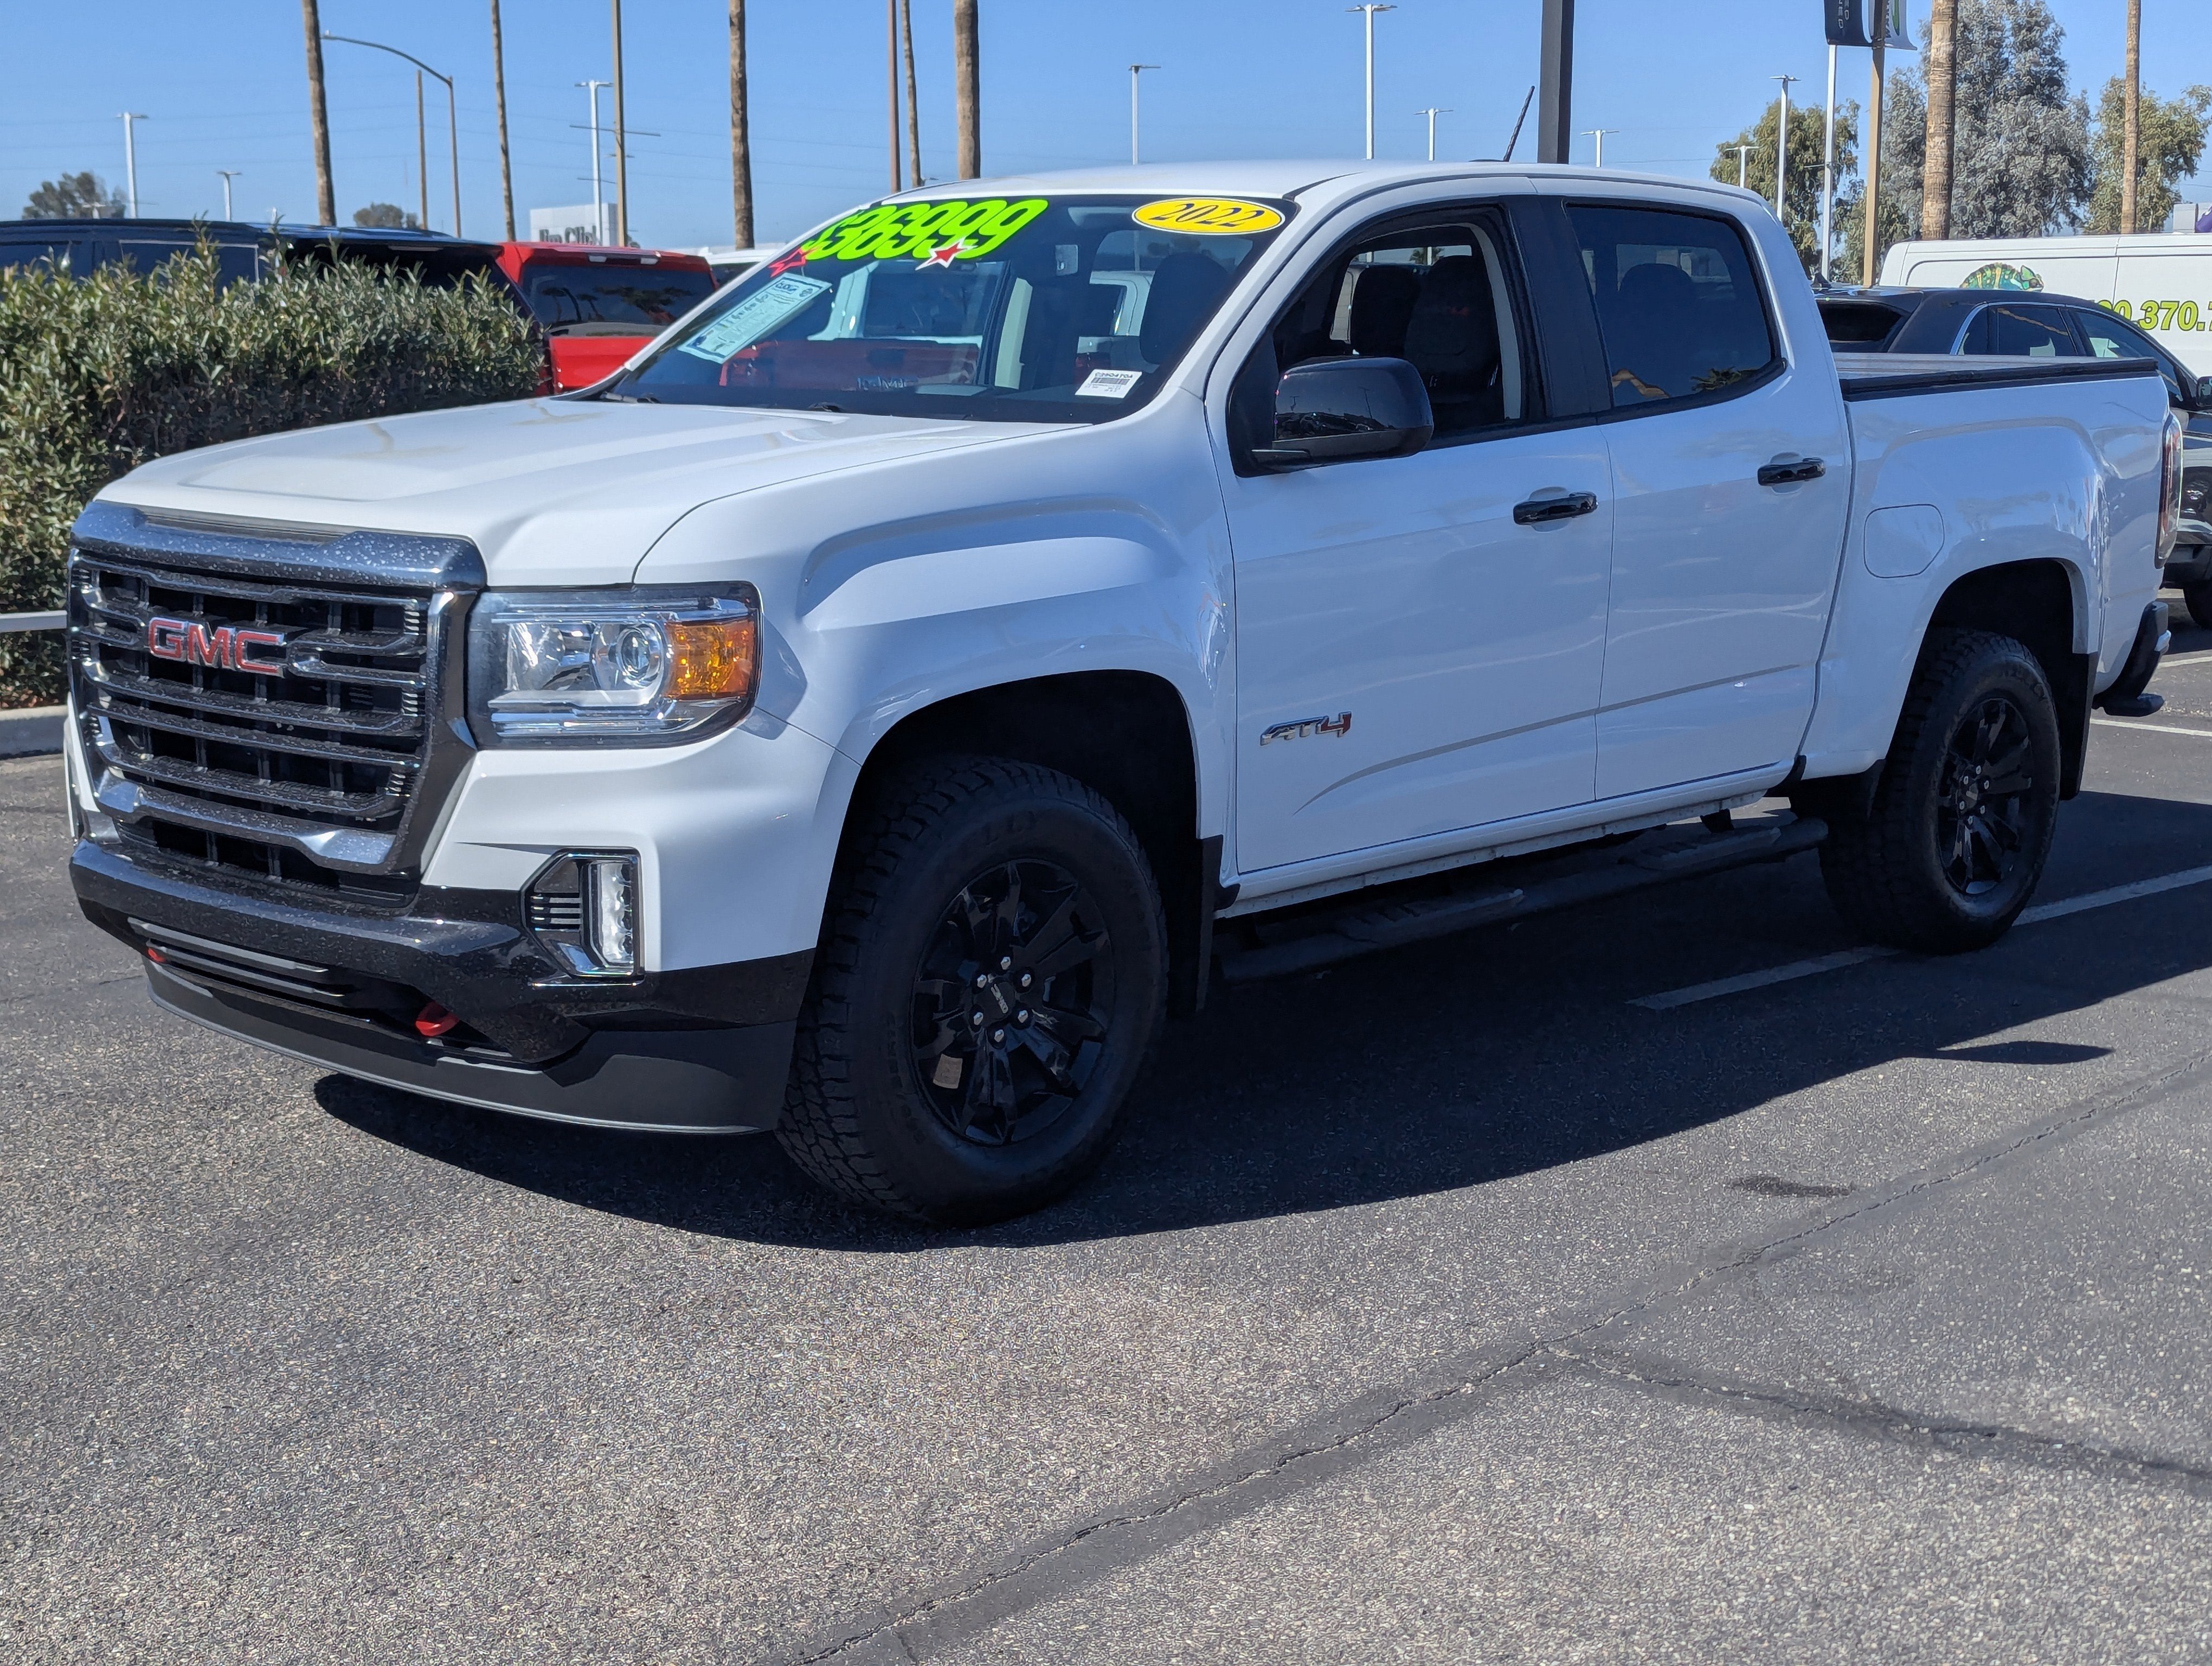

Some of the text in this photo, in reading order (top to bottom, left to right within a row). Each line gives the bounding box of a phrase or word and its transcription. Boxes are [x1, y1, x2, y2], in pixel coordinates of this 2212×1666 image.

[800, 198, 1049, 261] $36999
[1148, 202, 1265, 228] 2022
[148, 617, 285, 678] GMC
[1259, 710, 1352, 746] AT4
